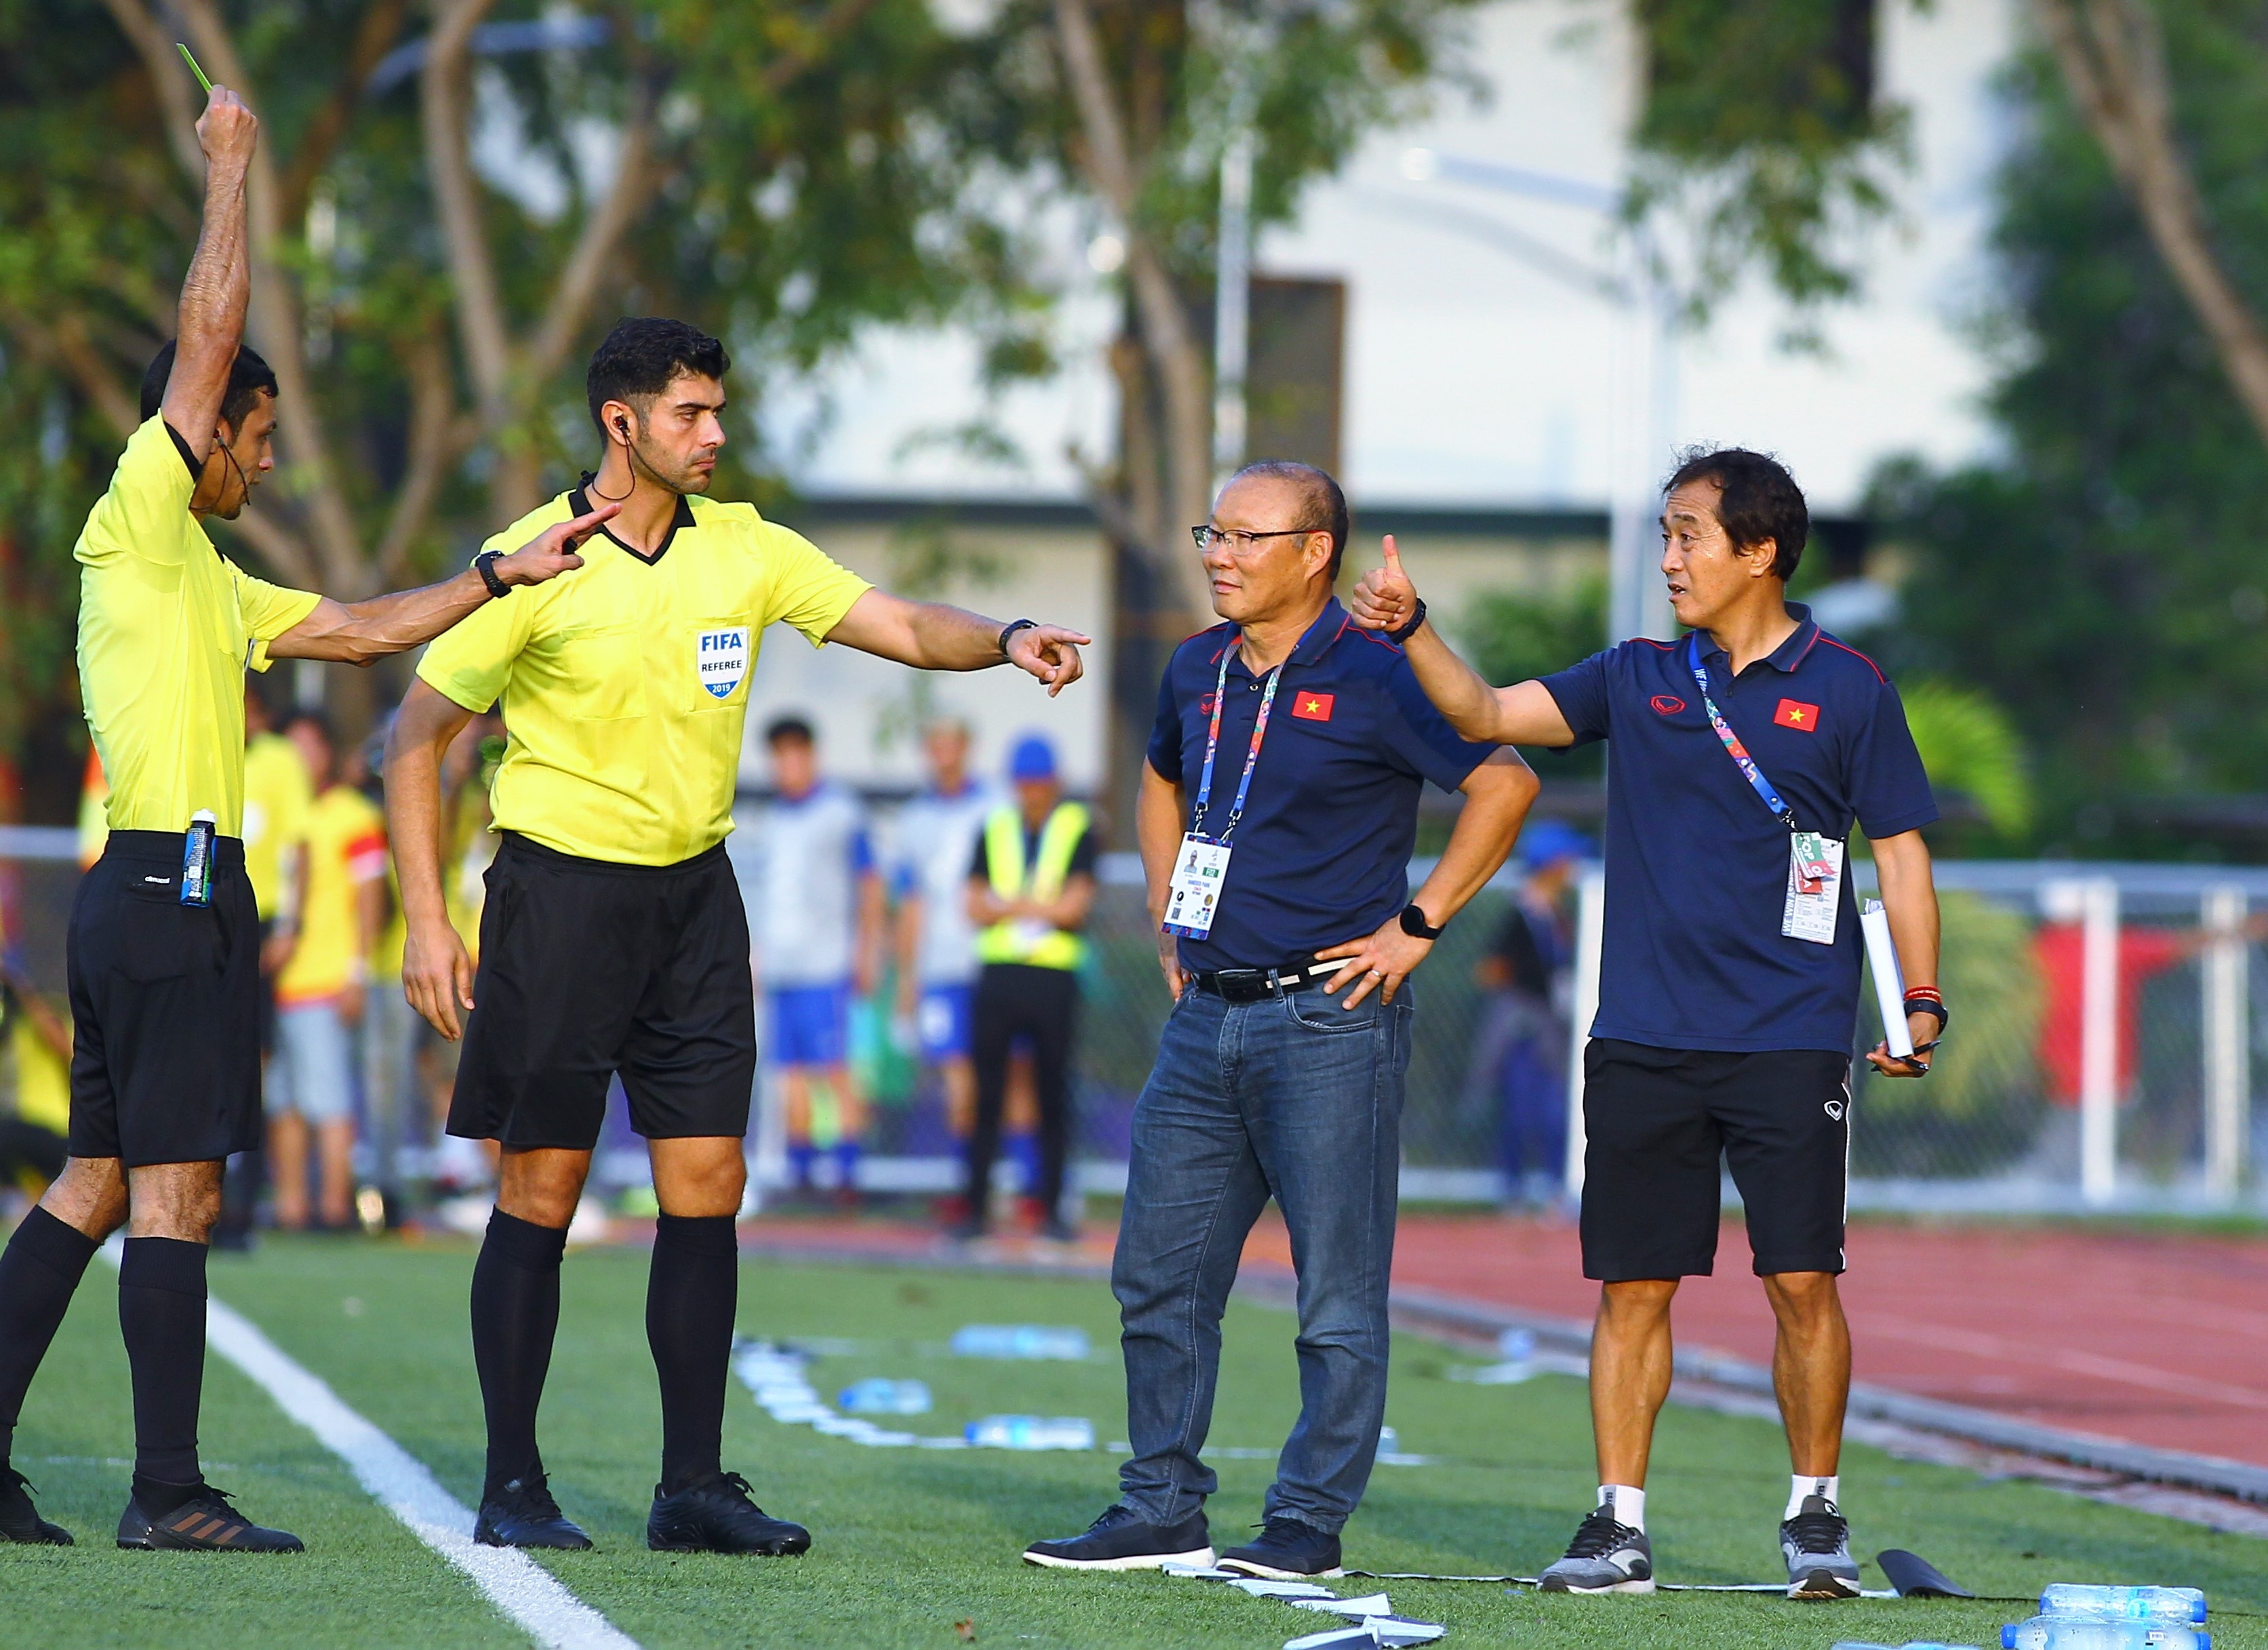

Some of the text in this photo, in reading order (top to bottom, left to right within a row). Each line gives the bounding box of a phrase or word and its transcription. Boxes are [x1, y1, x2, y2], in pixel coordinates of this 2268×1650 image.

[702, 632, 742, 651] FIFA
[702, 660, 742, 672] REFEREE
[712, 683, 730, 693] 2019
[1785, 900, 1795, 917] WIN
[1783, 920, 1791, 932] WE
